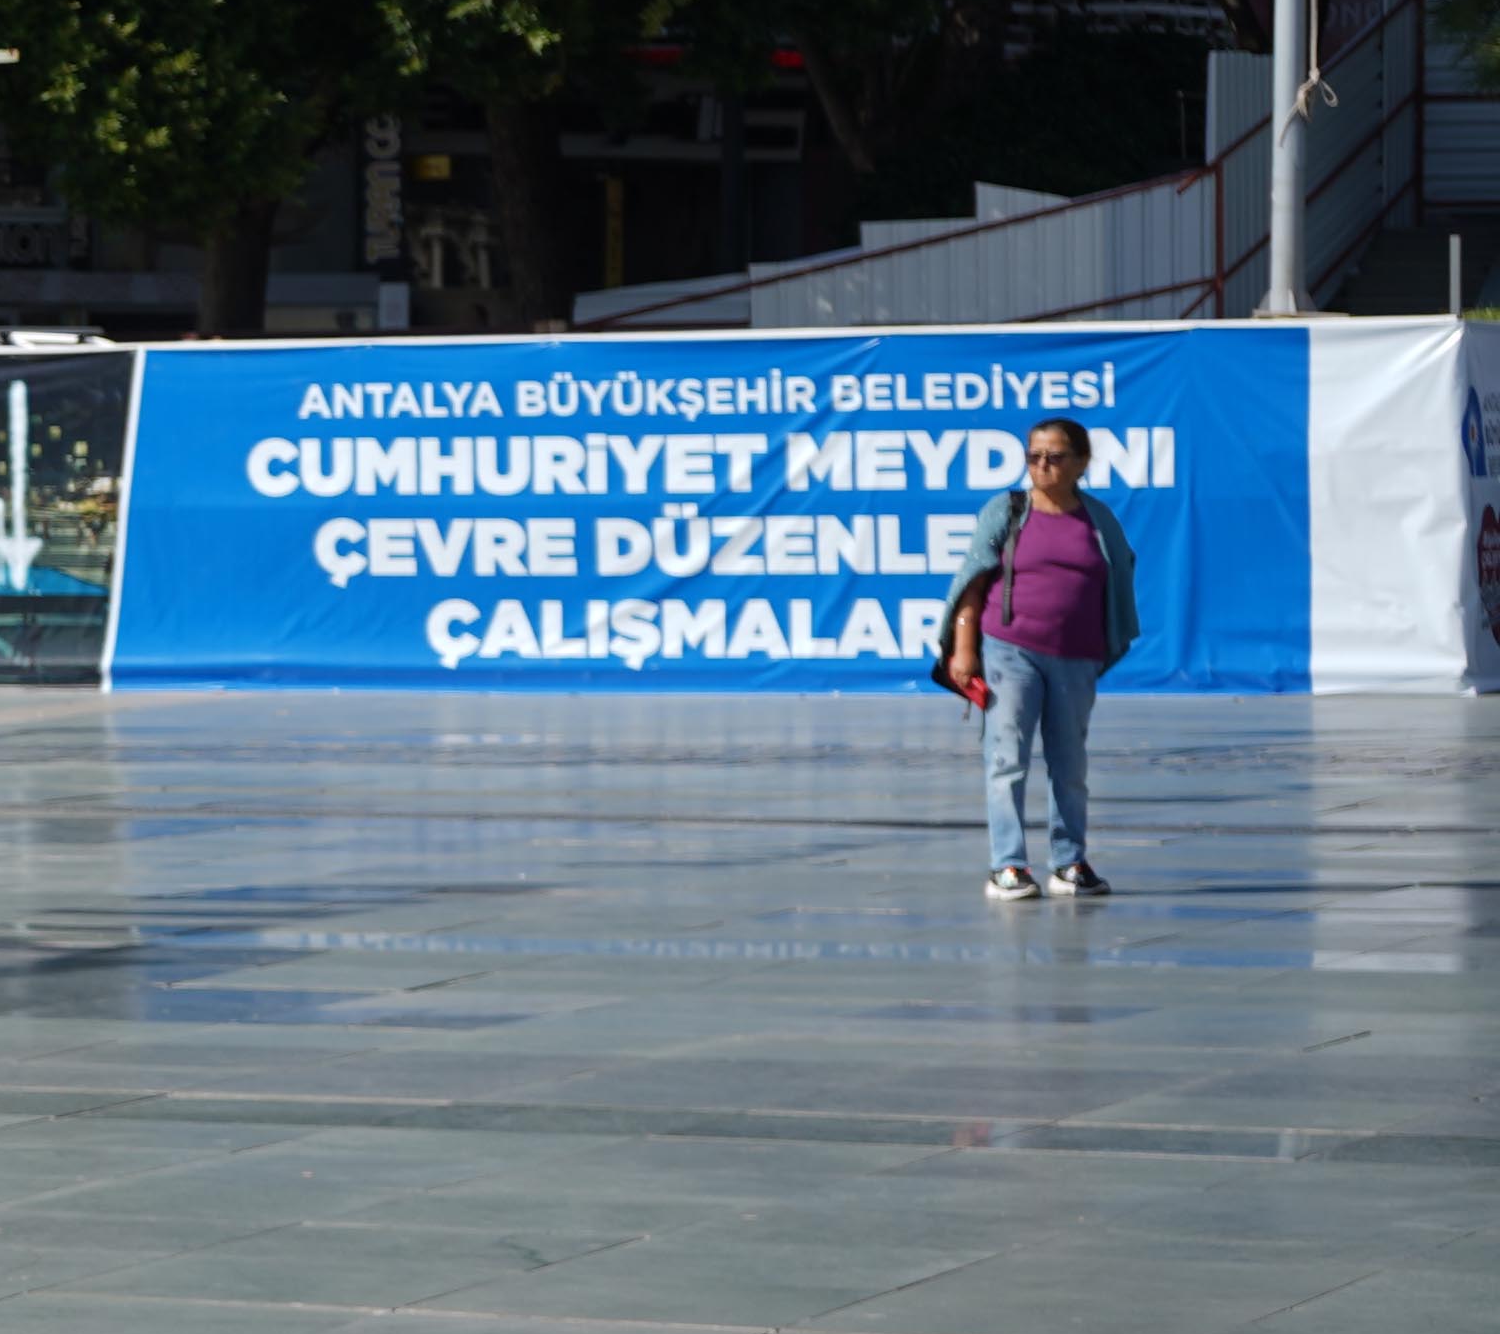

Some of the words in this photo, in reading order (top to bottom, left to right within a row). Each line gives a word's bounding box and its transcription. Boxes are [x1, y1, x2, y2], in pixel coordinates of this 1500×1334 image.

[299, 381, 504, 419] ANTALYA
[515, 369, 817, 422] BÜYÜKŞEHİR
[831, 361, 1116, 413] BELEDİYESİ
[245, 432, 768, 498] CUMHURİYET
[786, 426, 1176, 492] MEYDNI
[313, 516, 578, 589] ÇEVRE
[596, 502, 977, 577] DÜZENLE
